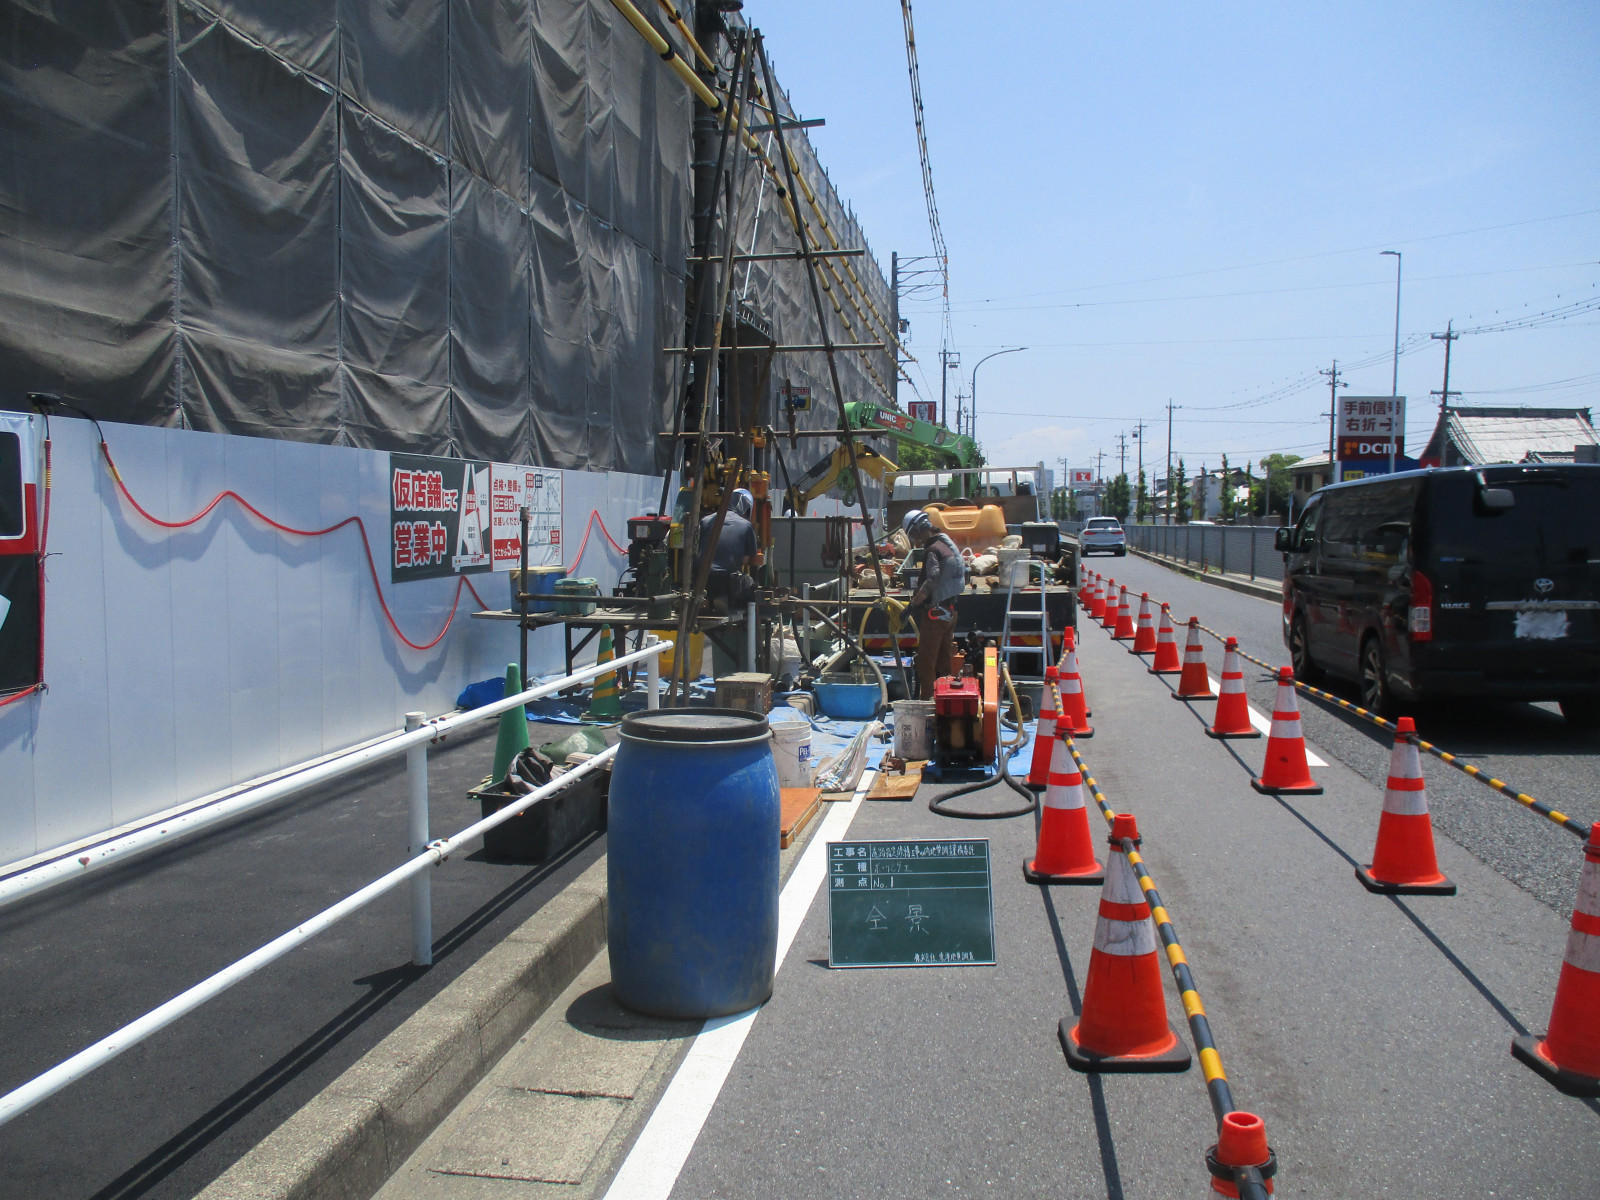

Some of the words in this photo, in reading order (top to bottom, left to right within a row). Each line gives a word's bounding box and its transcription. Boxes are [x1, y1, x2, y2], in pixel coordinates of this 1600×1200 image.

[1344, 401, 1400, 415] 手前信号
[879, 410, 897, 423] UNIC
[1346, 418, 1376, 432] 右折
[393, 468, 458, 511] 仮店舗にて
[394, 521, 447, 568] 営業中
[834, 847, 867, 857] 工事名
